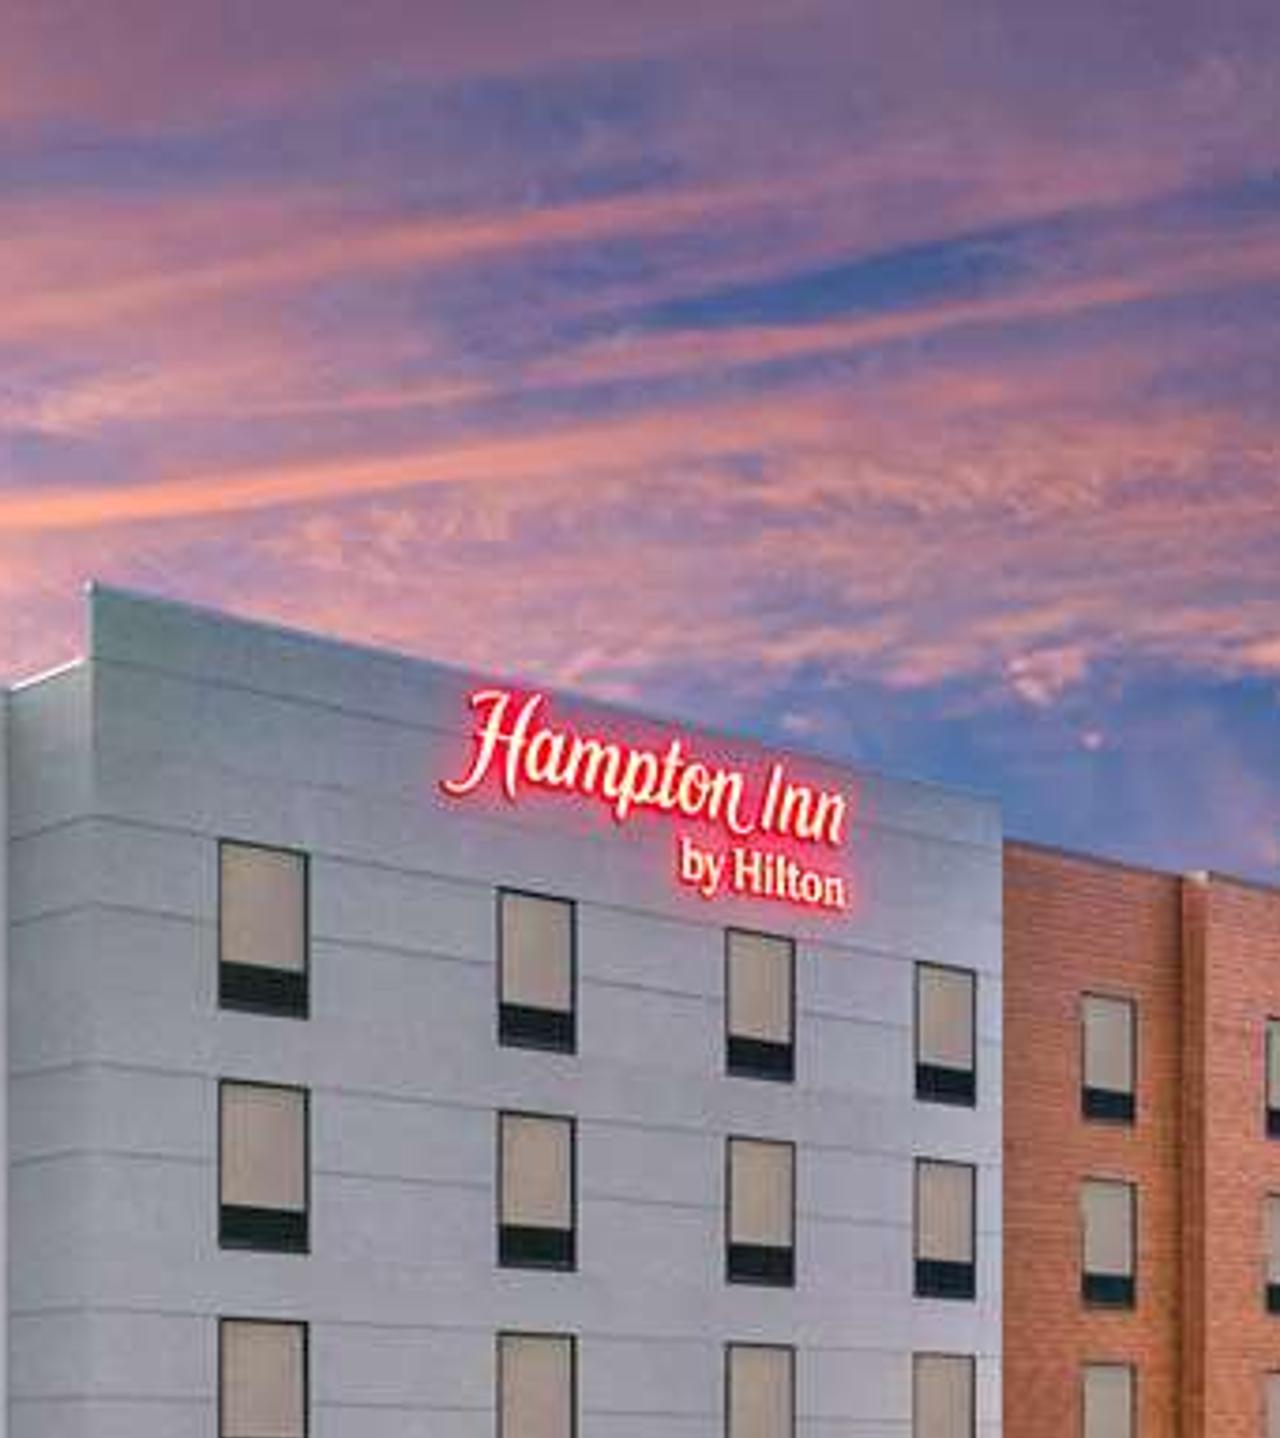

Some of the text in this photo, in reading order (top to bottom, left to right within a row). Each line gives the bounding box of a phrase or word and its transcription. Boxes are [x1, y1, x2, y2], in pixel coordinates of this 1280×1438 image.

[441, 689, 848, 844] Hampton Inn
[680, 835, 848, 908] by Hilton
